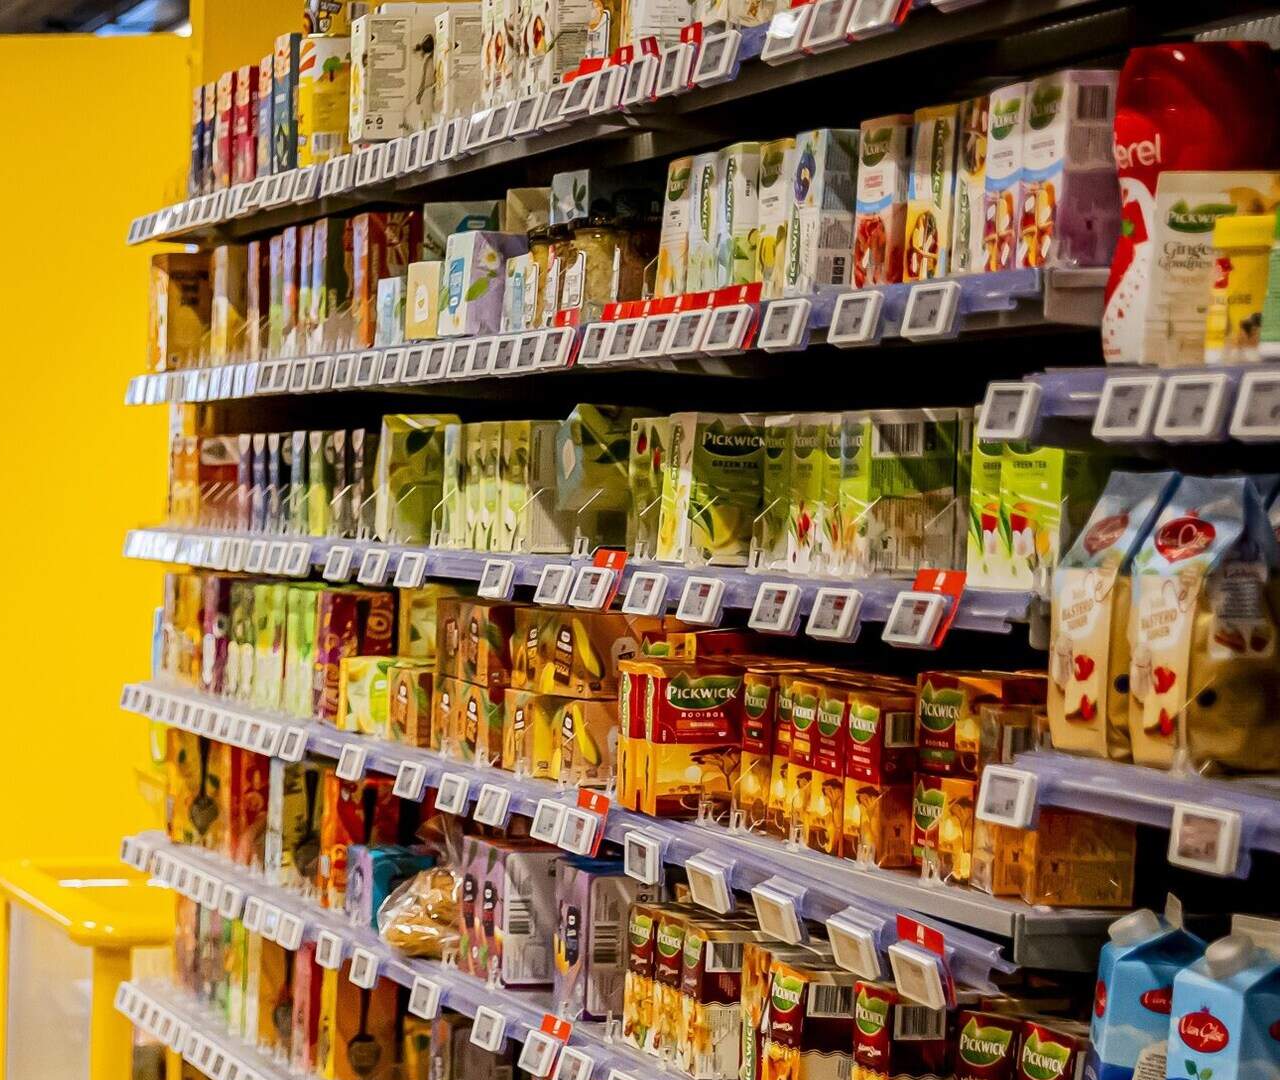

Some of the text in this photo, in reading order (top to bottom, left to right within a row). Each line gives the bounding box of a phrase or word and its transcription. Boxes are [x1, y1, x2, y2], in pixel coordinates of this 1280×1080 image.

[1167, 210, 1218, 226] PICKWI
[1163, 240, 1212, 261] Ginge
[702, 430, 766, 449] PICKWICK
[666, 685, 737, 701] PICKWICK
[681, 711, 725, 719] ROOIBOS
[919, 698, 961, 721] PICKWICK
[959, 1033, 1007, 1058] PICKWICK
[1022, 1046, 1065, 1077] PICKWICK
